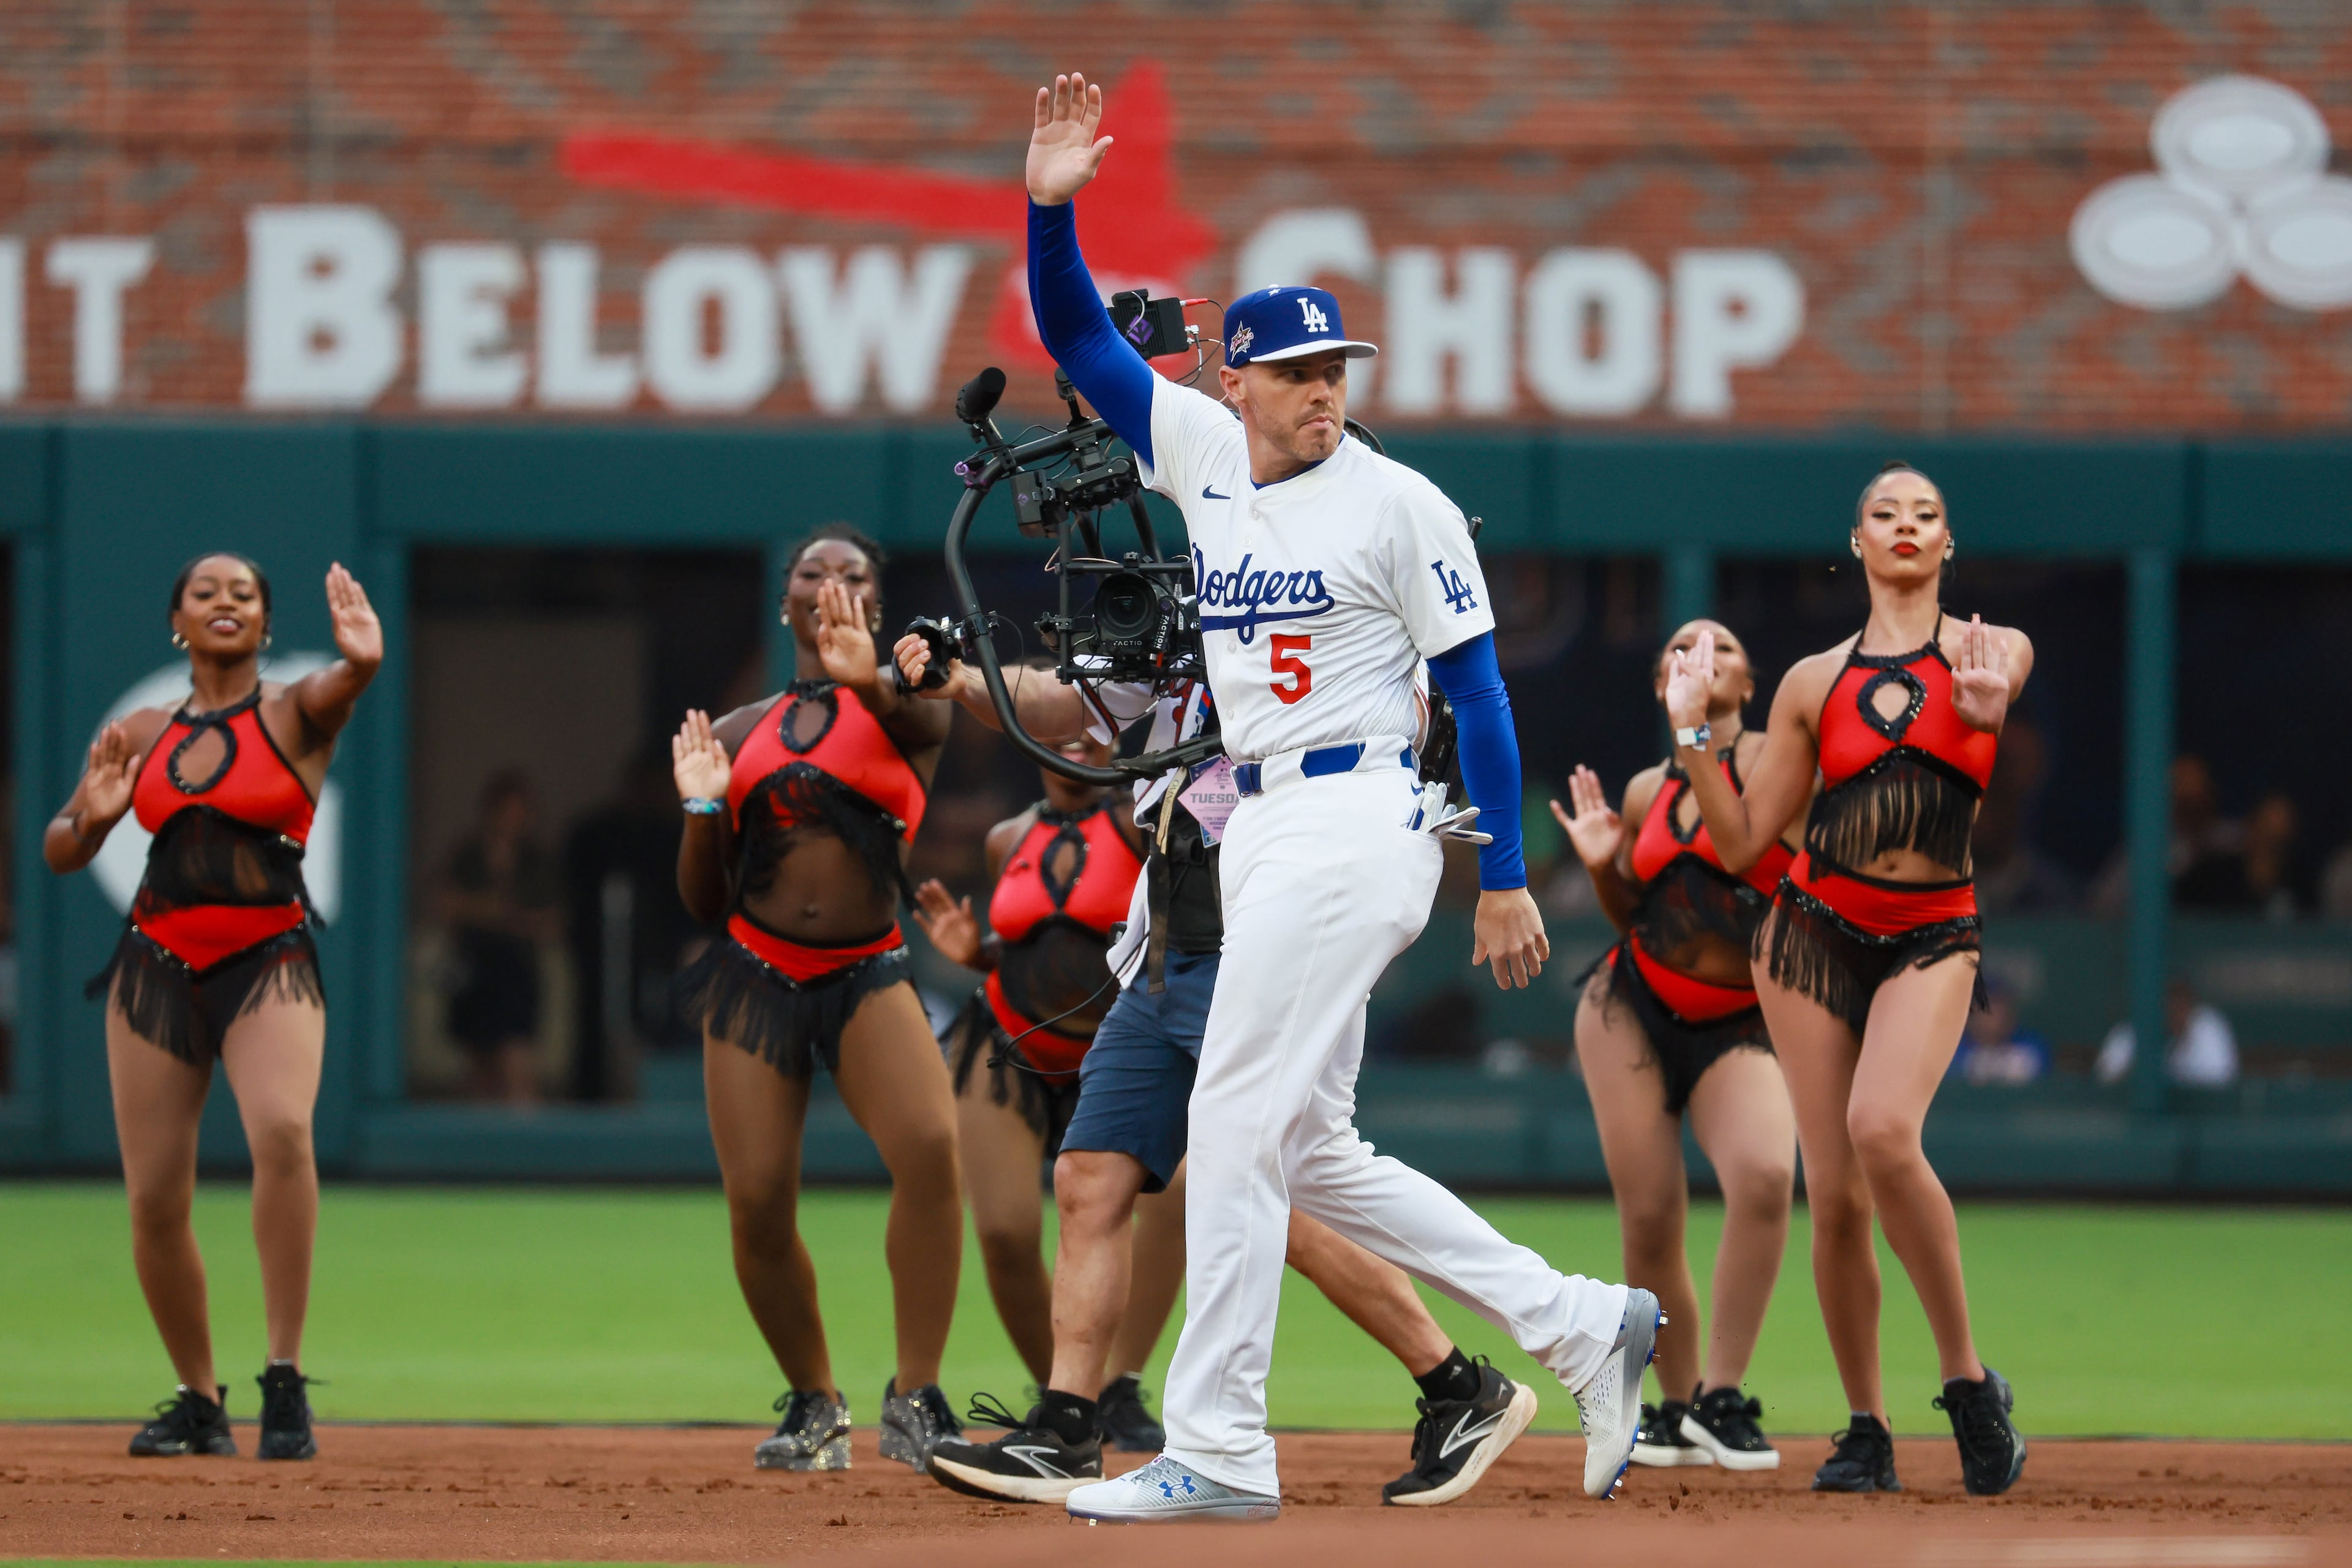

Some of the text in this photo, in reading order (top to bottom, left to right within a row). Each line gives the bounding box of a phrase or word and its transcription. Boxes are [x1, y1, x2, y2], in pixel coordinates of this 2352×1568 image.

[0, 236, 154, 407] T
[246, 203, 974, 413] BELOW
[1297, 297, 1329, 333] LA
[1431, 559, 1478, 614] LA
[1155, 615, 1170, 649] FACTION
[1269, 633, 1312, 704] 5
[1190, 793, 1240, 804] TUESD
